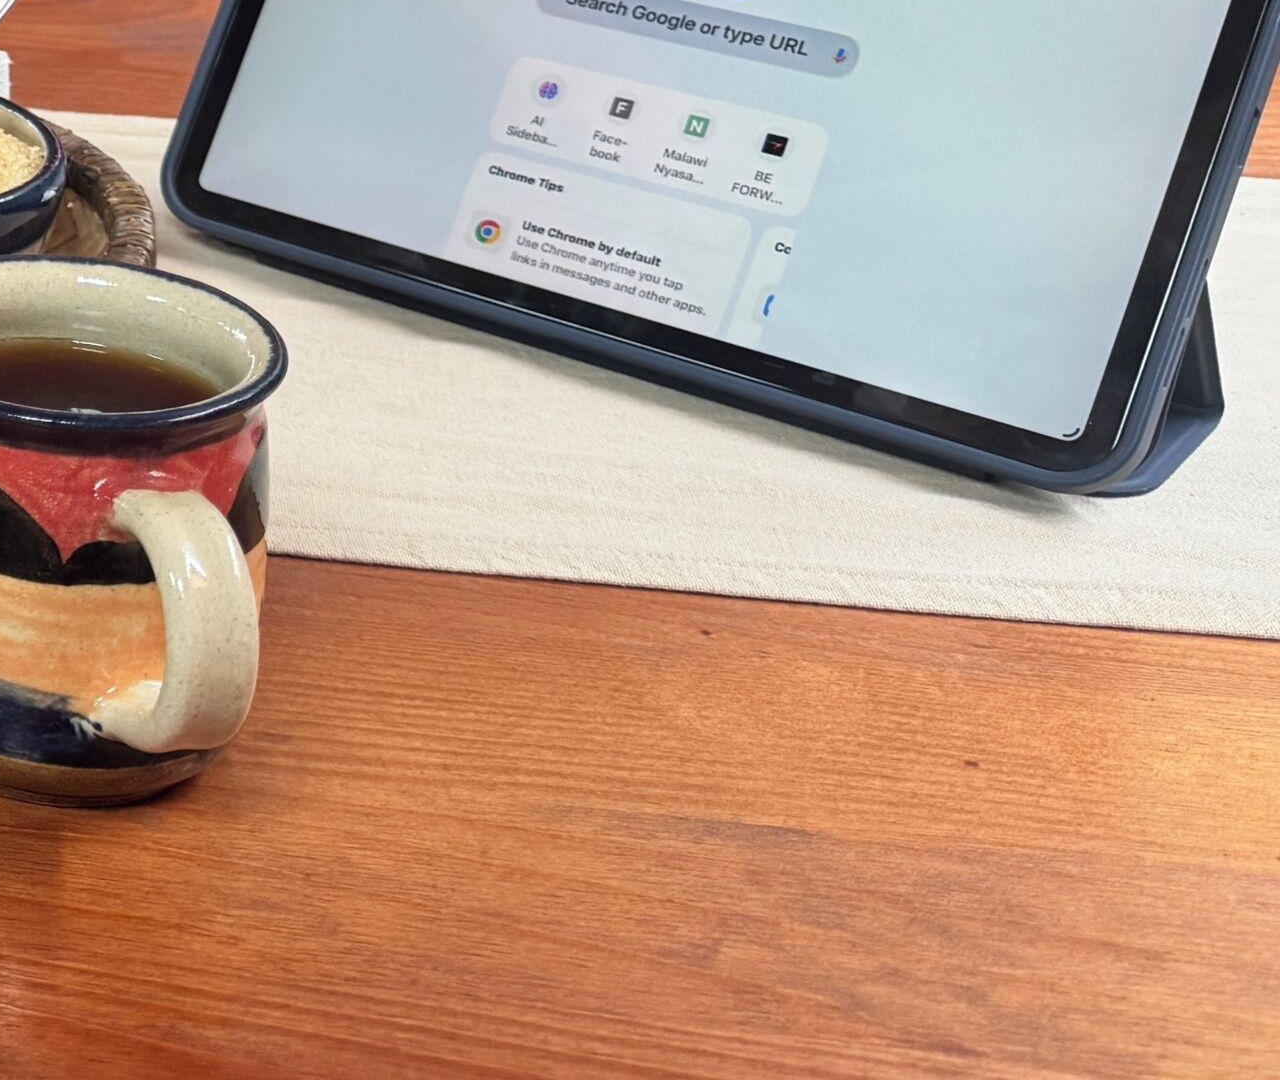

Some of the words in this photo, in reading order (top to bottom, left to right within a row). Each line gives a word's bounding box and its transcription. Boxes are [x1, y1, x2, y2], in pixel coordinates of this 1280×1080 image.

[631, 5, 696, 32] Google
[700, 21, 721, 36] or
[723, 25, 766, 46] type
[769, 33, 809, 56] URL
[592, 130, 629, 146] Face-
[589, 146, 621, 163] book
[662, 147, 709, 168] Malawi
[488, 164, 536, 186] Chrome
[539, 177, 565, 194] Tips
[754, 170, 774, 184] BE
[522, 220, 545, 235] Use
[547, 227, 596, 249] Chrome
[597, 240, 614, 255] by
[615, 246, 662, 267] default
[516, 235, 539, 250] Use
[540, 242, 587, 264] Chrome
[588, 257, 637, 278] anytime
[638, 272, 662, 287] you
[663, 277, 684, 291] tap
[510, 250, 538, 267] links
[539, 258, 551, 271] in
[551, 262, 611, 288] messages
[612, 279, 638, 296] and
[638, 288, 672, 306] other
[672, 297, 707, 316] apps.
